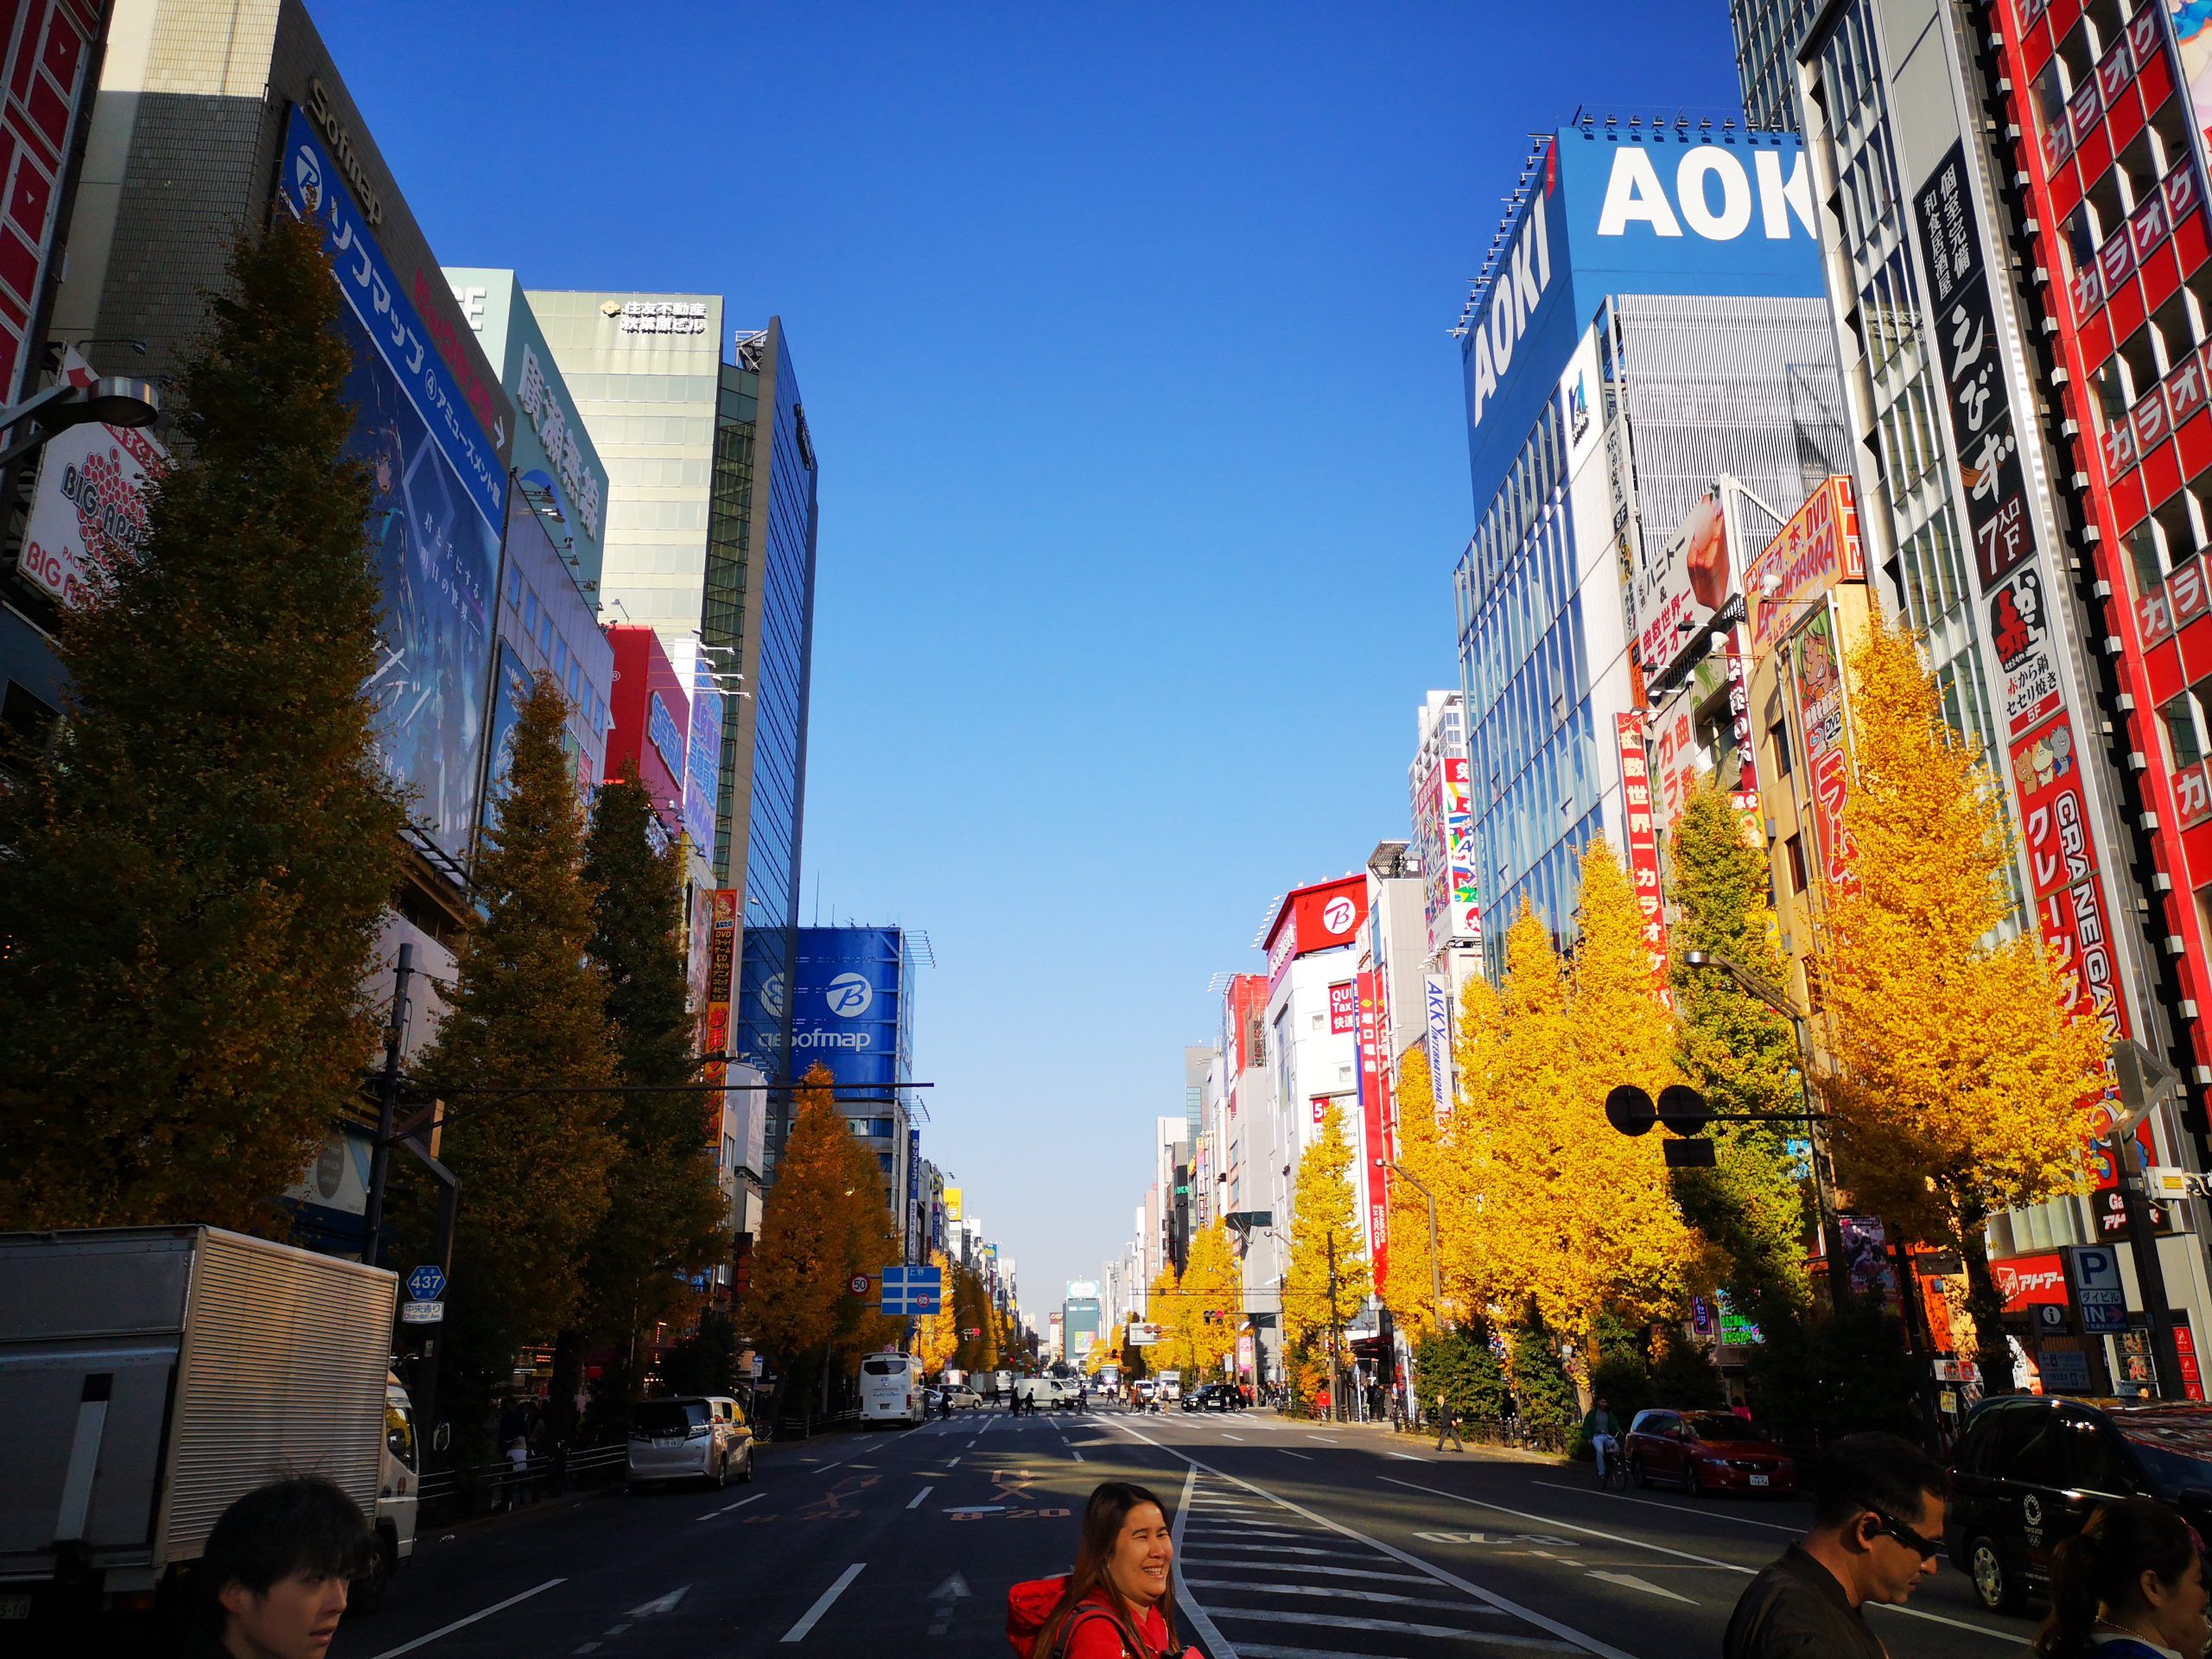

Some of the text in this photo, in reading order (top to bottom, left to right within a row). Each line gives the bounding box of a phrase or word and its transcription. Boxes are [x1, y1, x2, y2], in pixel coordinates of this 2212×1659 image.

[1940, 162, 1971, 283] 個室完備
[1923, 188, 1954, 303] 和食居酒屋
[621, 317, 705, 333] 秋葉原ビル
[623, 301, 707, 317] 住友不動産
[1474, 188, 1552, 429] AOKI
[61, 462, 98, 518] BIG
[26, 542, 62, 588] BIG
[1646, 537, 1686, 596] ハニトー
[2006, 671, 2057, 716] セセリ焼き
[648, 690, 683, 791] SEGA
[2054, 793, 2103, 949] CRANE
[410, 1274, 442, 1289] 437
[854, 1279, 867, 1290] 50
[909, 1268, 925, 1277] 上野
[2078, 1252, 2108, 1286] P
[405, 1305, 441, 1313] 中央通り
[2082, 1291, 2119, 1304] ダイビル
[2083, 1305, 2107, 1323] IN
